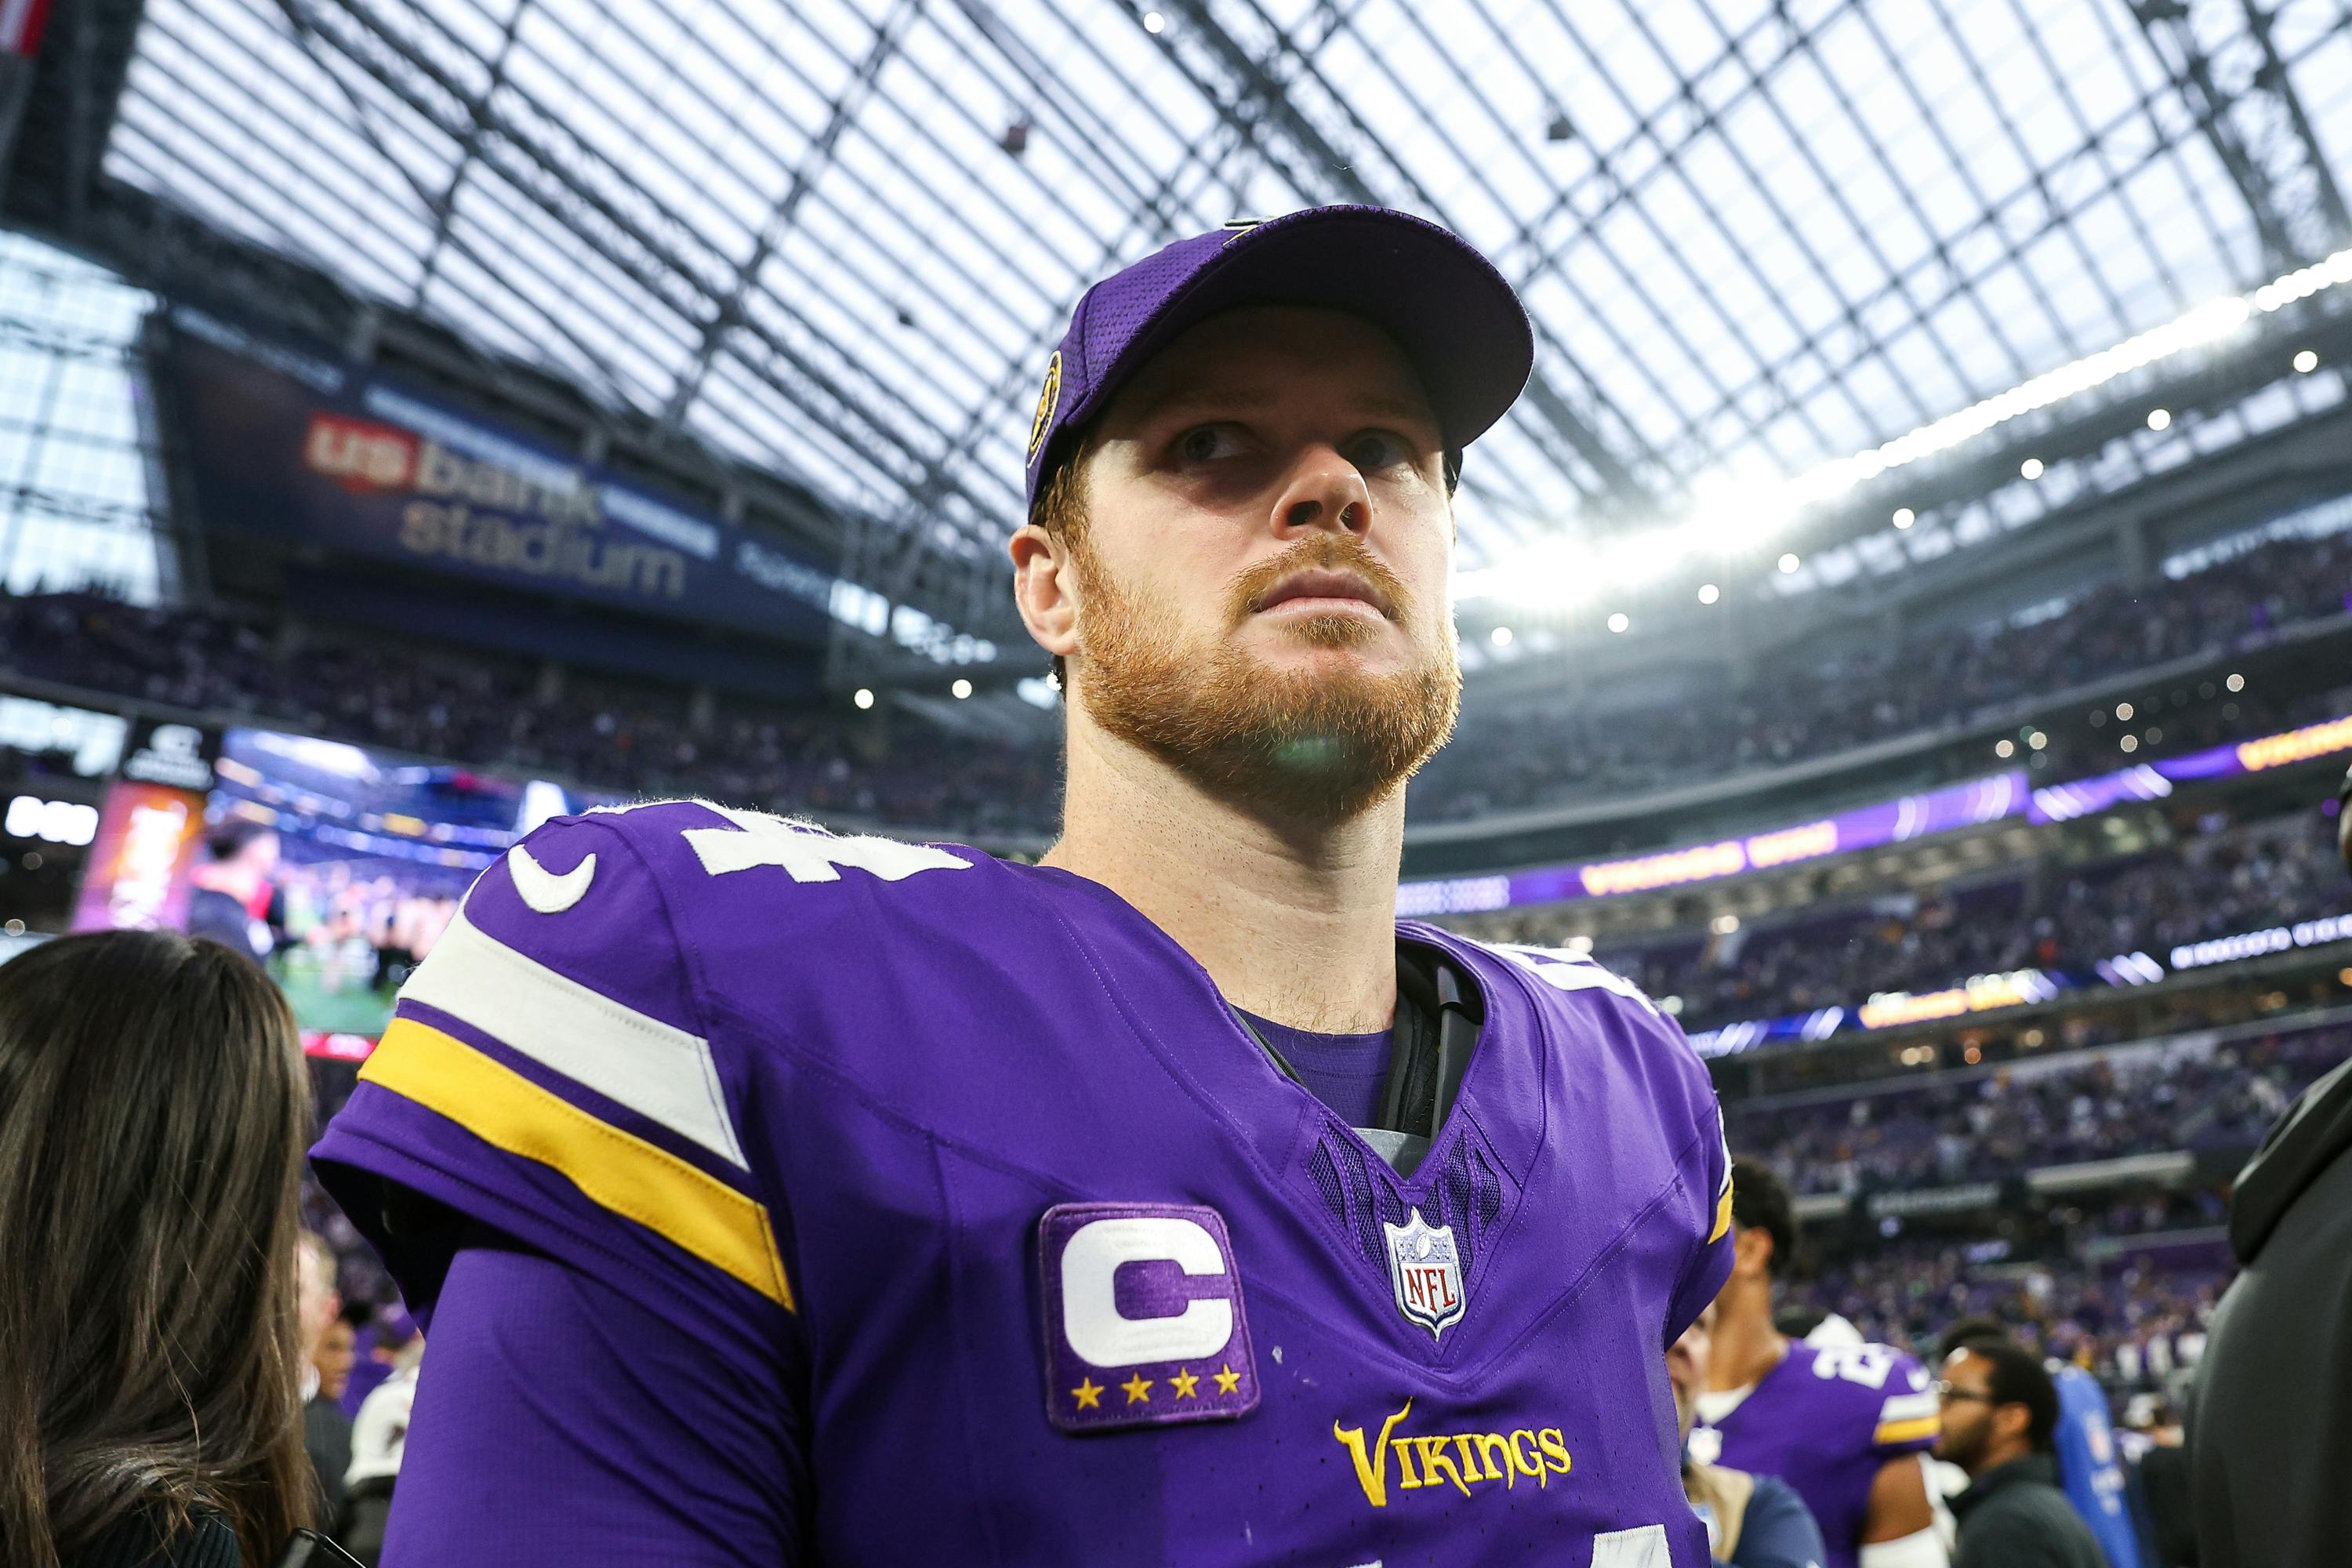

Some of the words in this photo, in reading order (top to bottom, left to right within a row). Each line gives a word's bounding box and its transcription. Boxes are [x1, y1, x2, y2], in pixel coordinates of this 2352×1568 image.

[398, 500, 686, 598] stadium
[1062, 1218, 1234, 1367] C
[1405, 1266, 1457, 1315] NFL
[1333, 1396, 1573, 1507] VIKINGS
